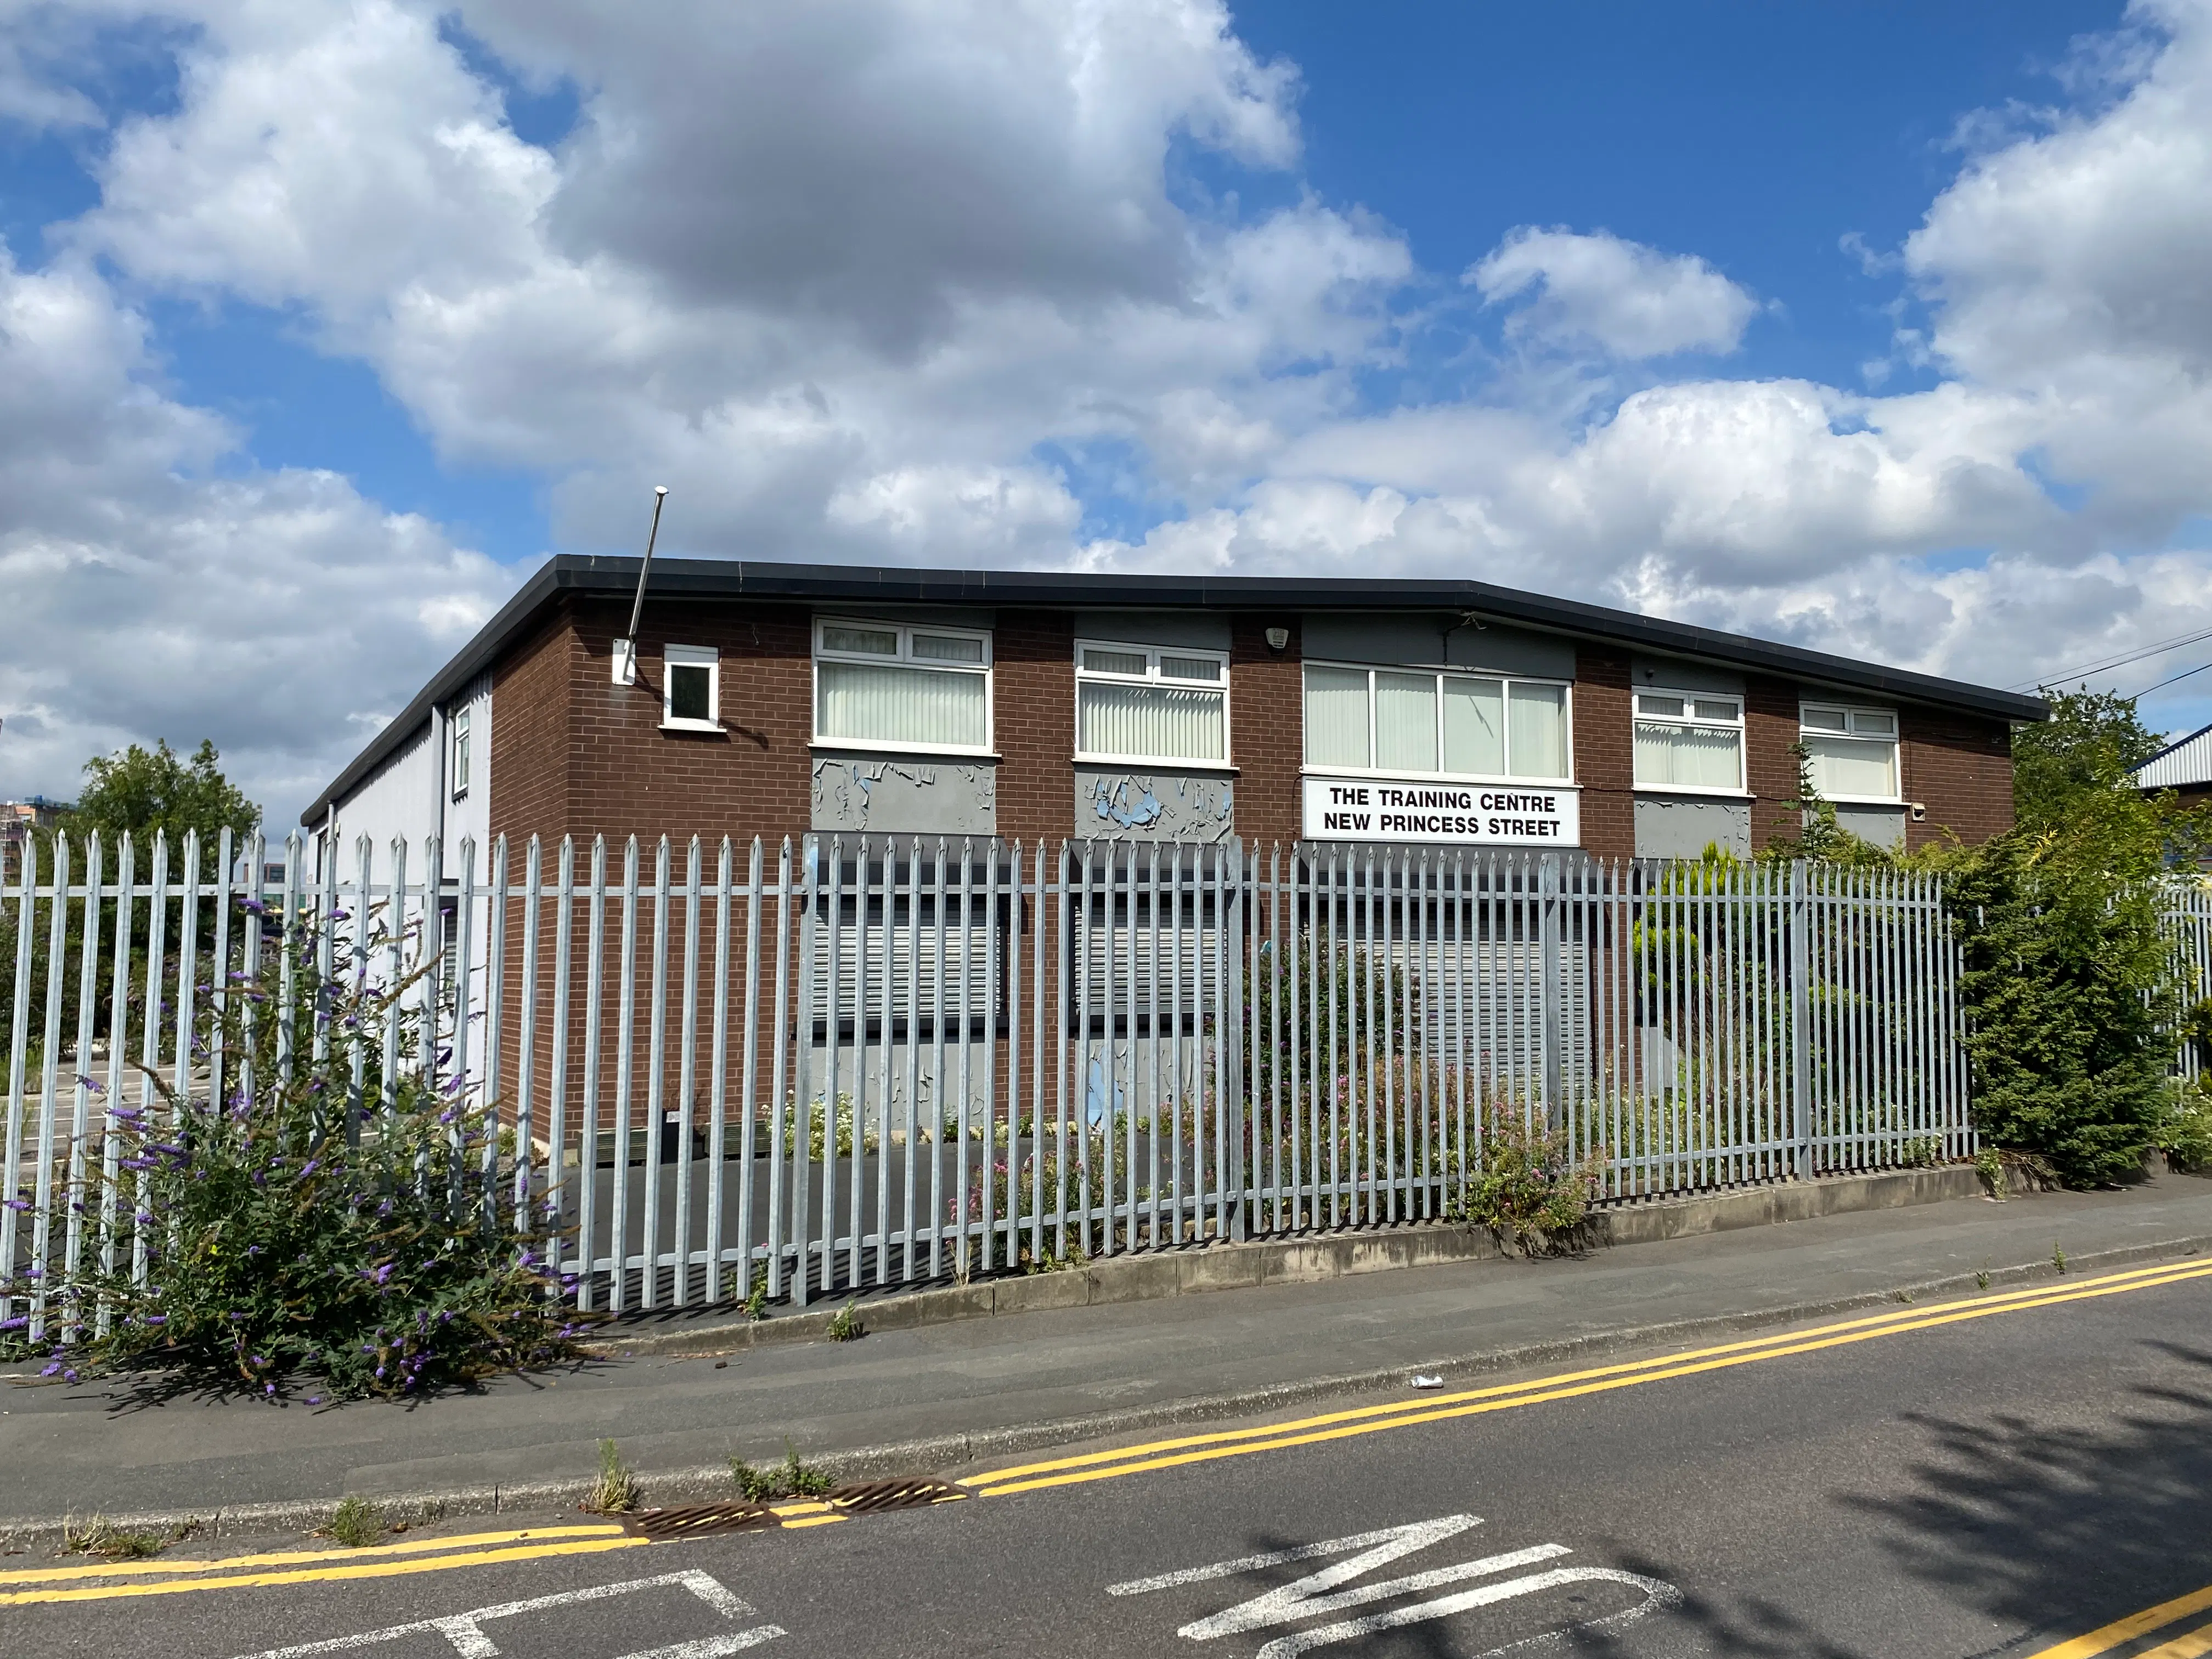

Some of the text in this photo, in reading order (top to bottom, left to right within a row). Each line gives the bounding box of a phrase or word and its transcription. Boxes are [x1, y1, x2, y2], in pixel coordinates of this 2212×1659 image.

[1330, 788, 1555, 812] THE TRAINING CENTRE
[1325, 813, 1560, 837] NEW PRINCESS STREET
